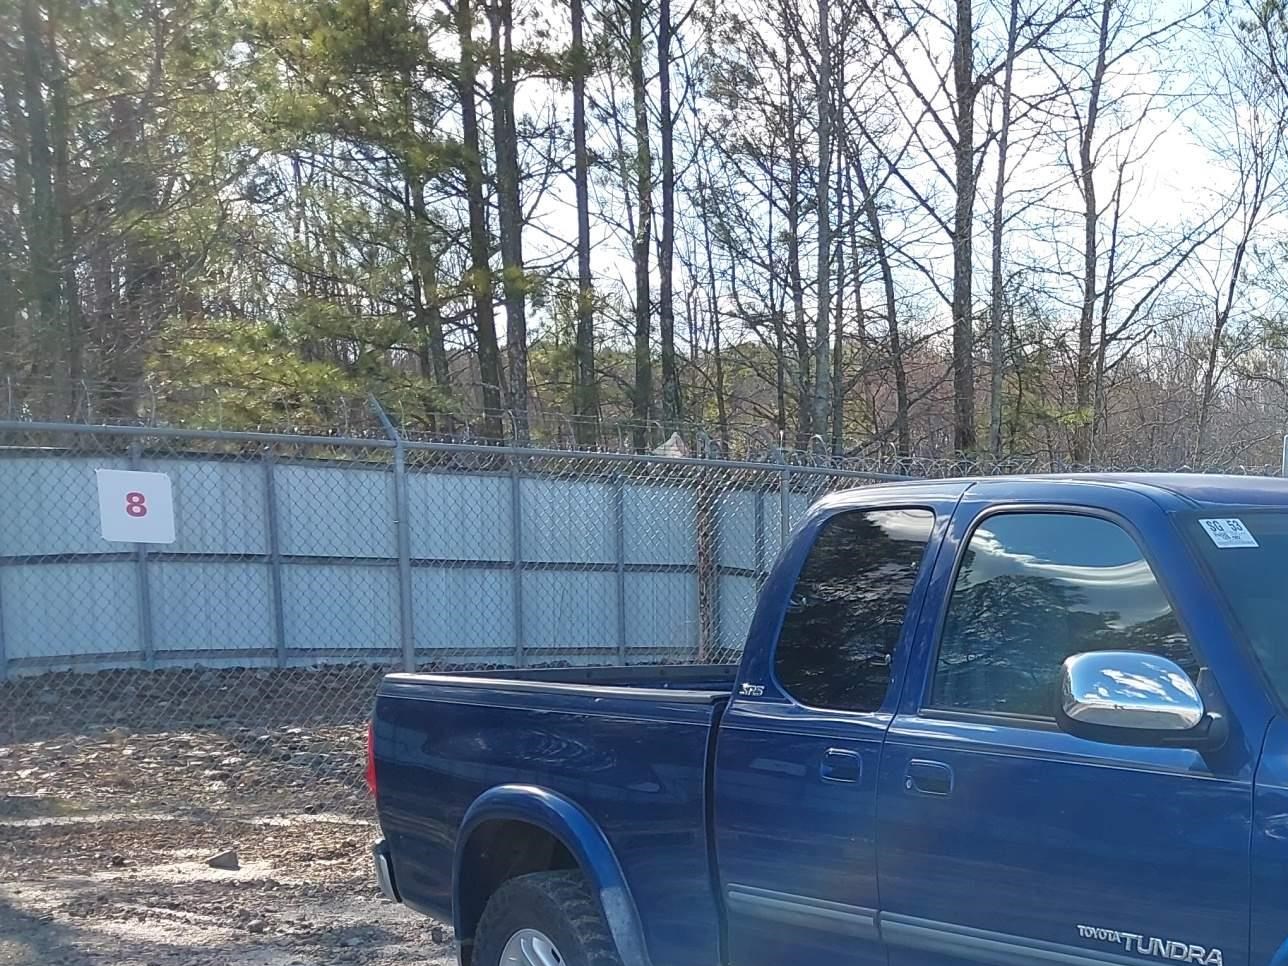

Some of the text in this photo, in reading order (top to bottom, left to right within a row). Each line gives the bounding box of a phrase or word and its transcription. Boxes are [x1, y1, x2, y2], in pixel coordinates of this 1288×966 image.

[126, 492, 147, 517] 8
[1226, 520, 1243, 531] 53
[1077, 924, 1121, 943] TOYOTA
